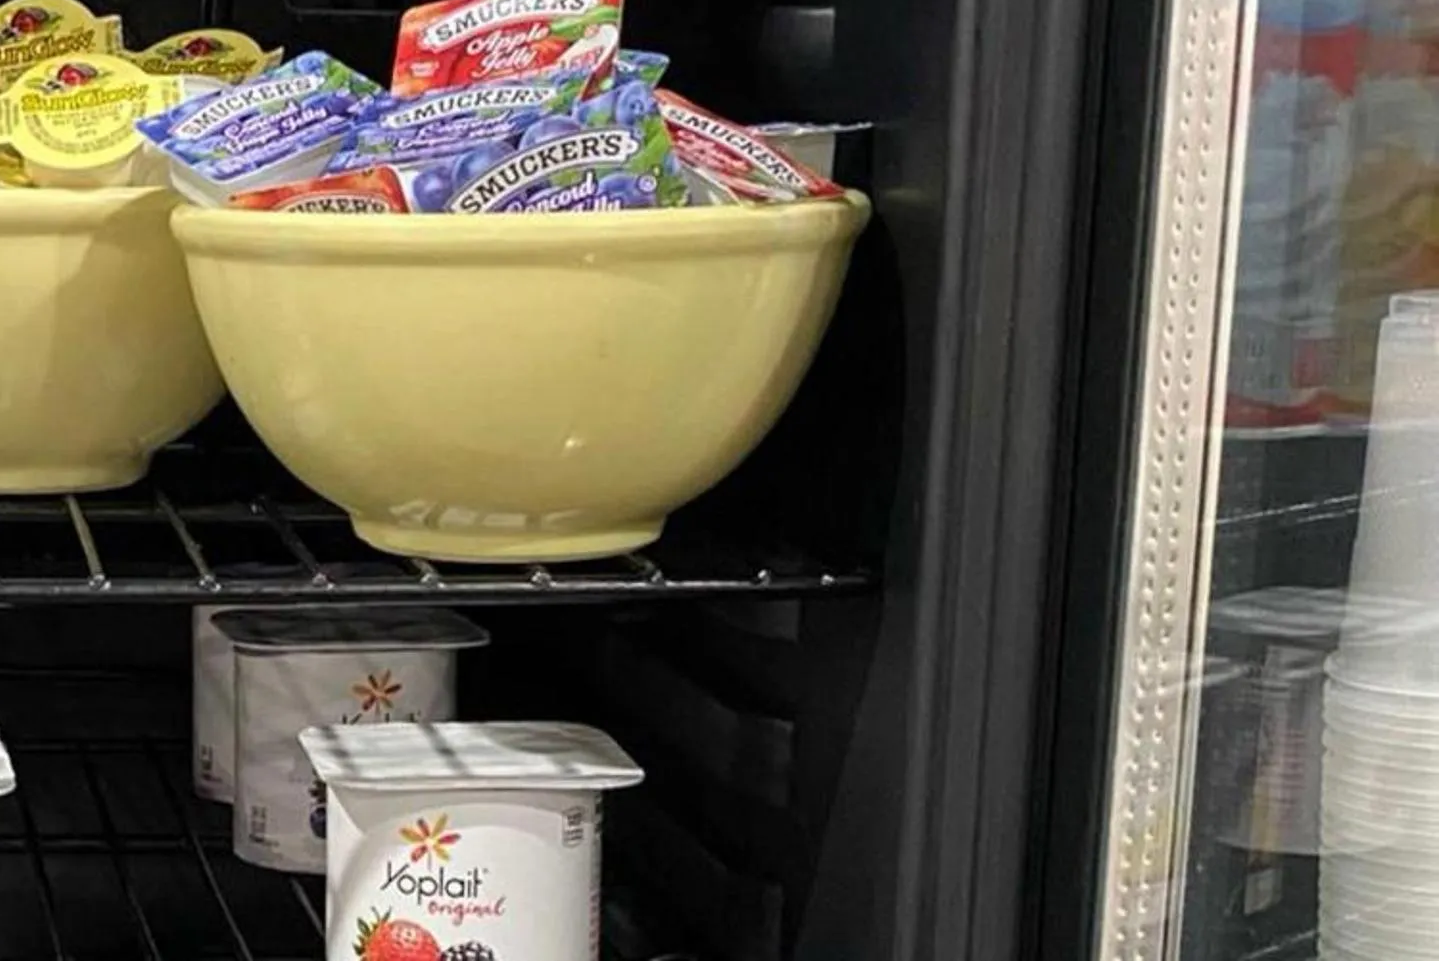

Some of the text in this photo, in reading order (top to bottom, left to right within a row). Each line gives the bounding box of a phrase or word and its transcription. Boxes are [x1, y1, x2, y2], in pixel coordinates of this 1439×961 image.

[466, 21, 550, 56] Apple
[471, 47, 538, 78] Jelly
[181, 76, 313, 136] SMUCKER'S
[395, 87, 550, 124] SMUCKER'S
[460, 133, 624, 214] SMUCKER'S
[380, 861, 485, 905] Yoplait
